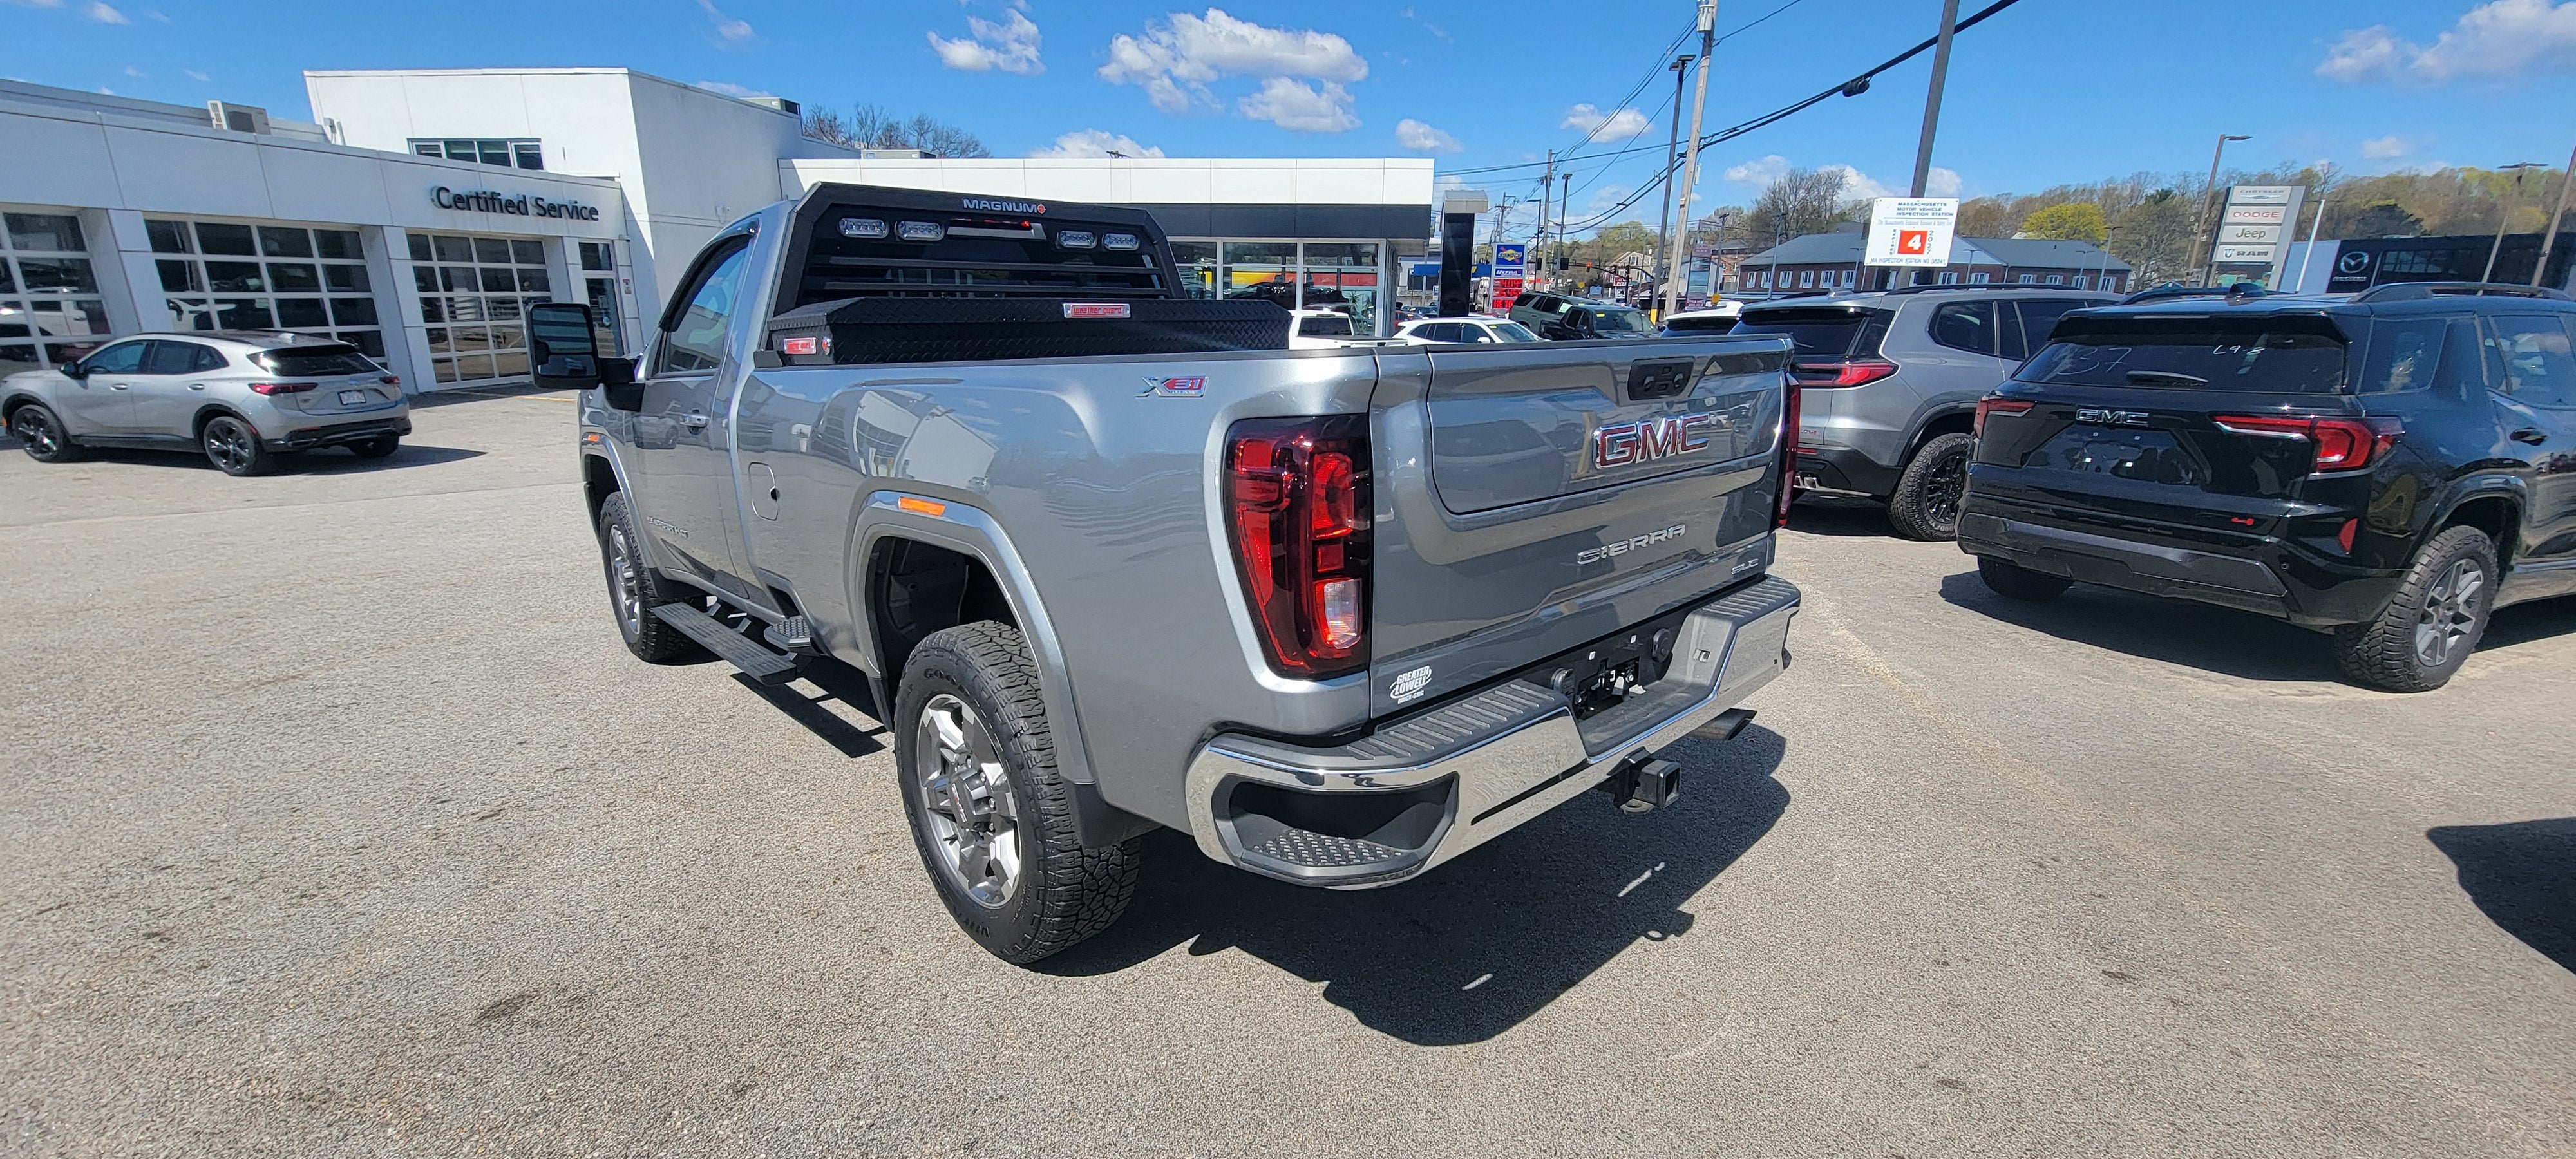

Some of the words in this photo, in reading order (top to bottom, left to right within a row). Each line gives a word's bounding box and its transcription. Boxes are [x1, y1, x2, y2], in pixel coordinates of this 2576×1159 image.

[433, 185, 529, 216] Certified
[533, 196, 600, 221] Service
[963, 198, 1037, 213] MAGNUM
[1907, 234, 1922, 250] 4
[2235, 228, 2266, 240] Jeep
[2076, 408, 2149, 427] GMC
[1593, 413, 1710, 469] GMC
[1578, 525, 1685, 565] SIERRA
[1396, 665, 1430, 684] GREATER
[1394, 676, 1427, 695] LOWELL
